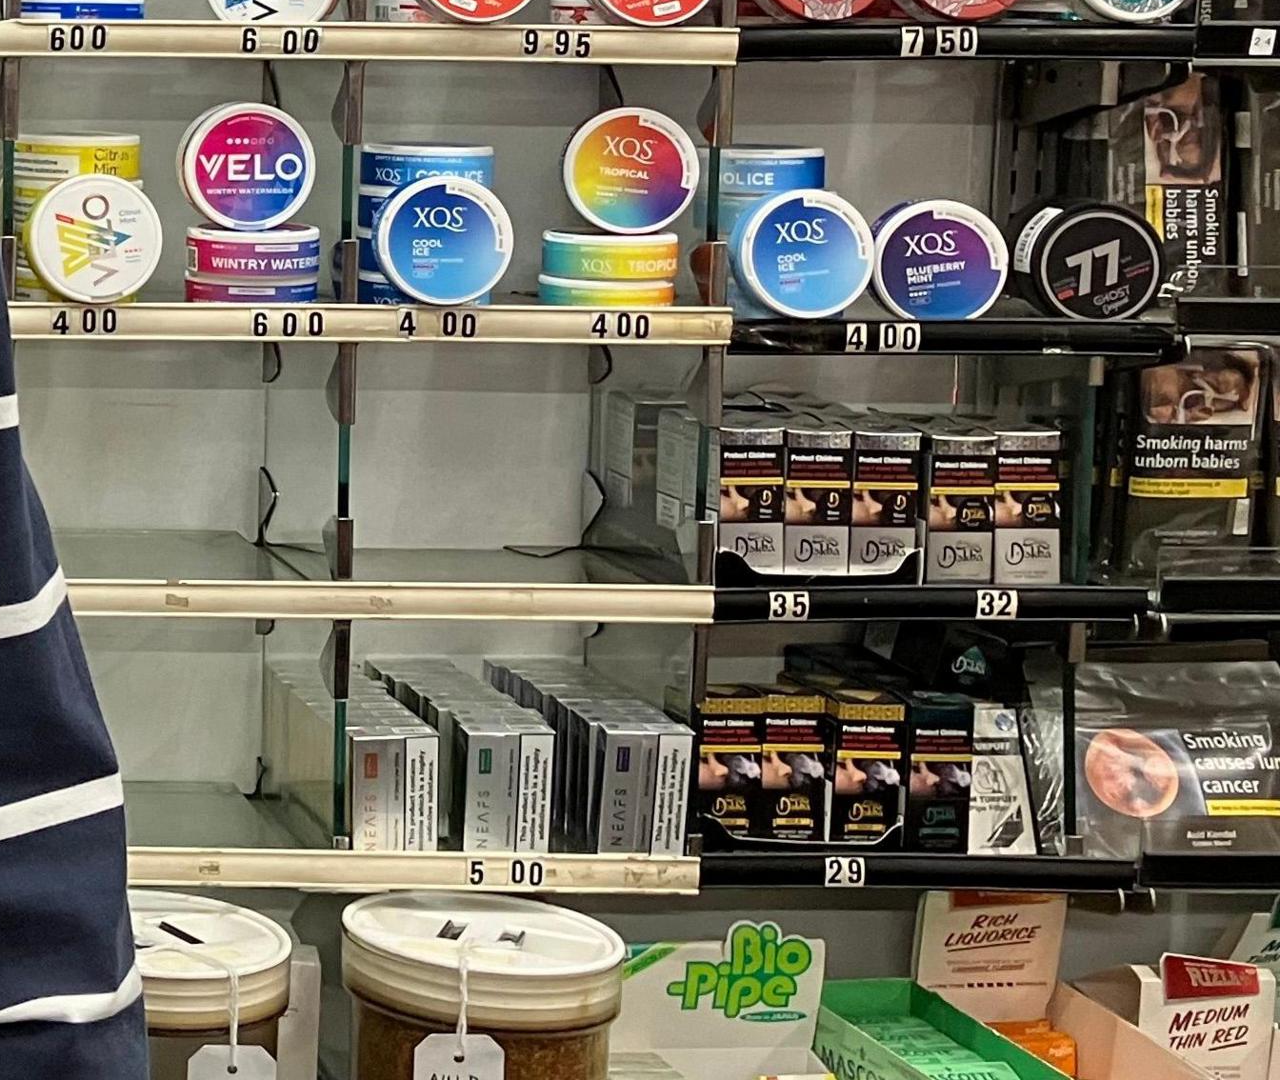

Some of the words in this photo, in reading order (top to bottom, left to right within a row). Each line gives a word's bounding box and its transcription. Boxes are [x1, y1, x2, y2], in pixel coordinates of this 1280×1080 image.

[603, 135, 654, 162] XQS
[200, 152, 303, 184] VELO
[598, 167, 649, 180] TROPICAL
[414, 206, 463, 232] XQS
[904, 230, 957, 258] XQS
[906, 261, 967, 276] BLUEBERRY
[906, 274, 933, 285] MINT
[1135, 433, 1200, 455] Smoking
[1204, 435, 1249, 453] harms
[1134, 453, 1186, 470] unborn
[1190, 452, 1241, 471] babies
[772, 593, 807, 617] 35
[980, 591, 1015, 616] 32
[1183, 731, 1267, 751] Smoking
[1195, 757, 1255, 769] causes
[1202, 780, 1260, 793] cancer
[827, 860, 863, 885] 29
[971, 914, 1018, 930] RICH
[944, 925, 1041, 948] LIQUORICE
[740, 923, 811, 976] Bio
[1168, 1003, 1250, 1035] MEDIUM
[1169, 1033, 1205, 1051] THIN
[1209, 1025, 1249, 1045] RED
